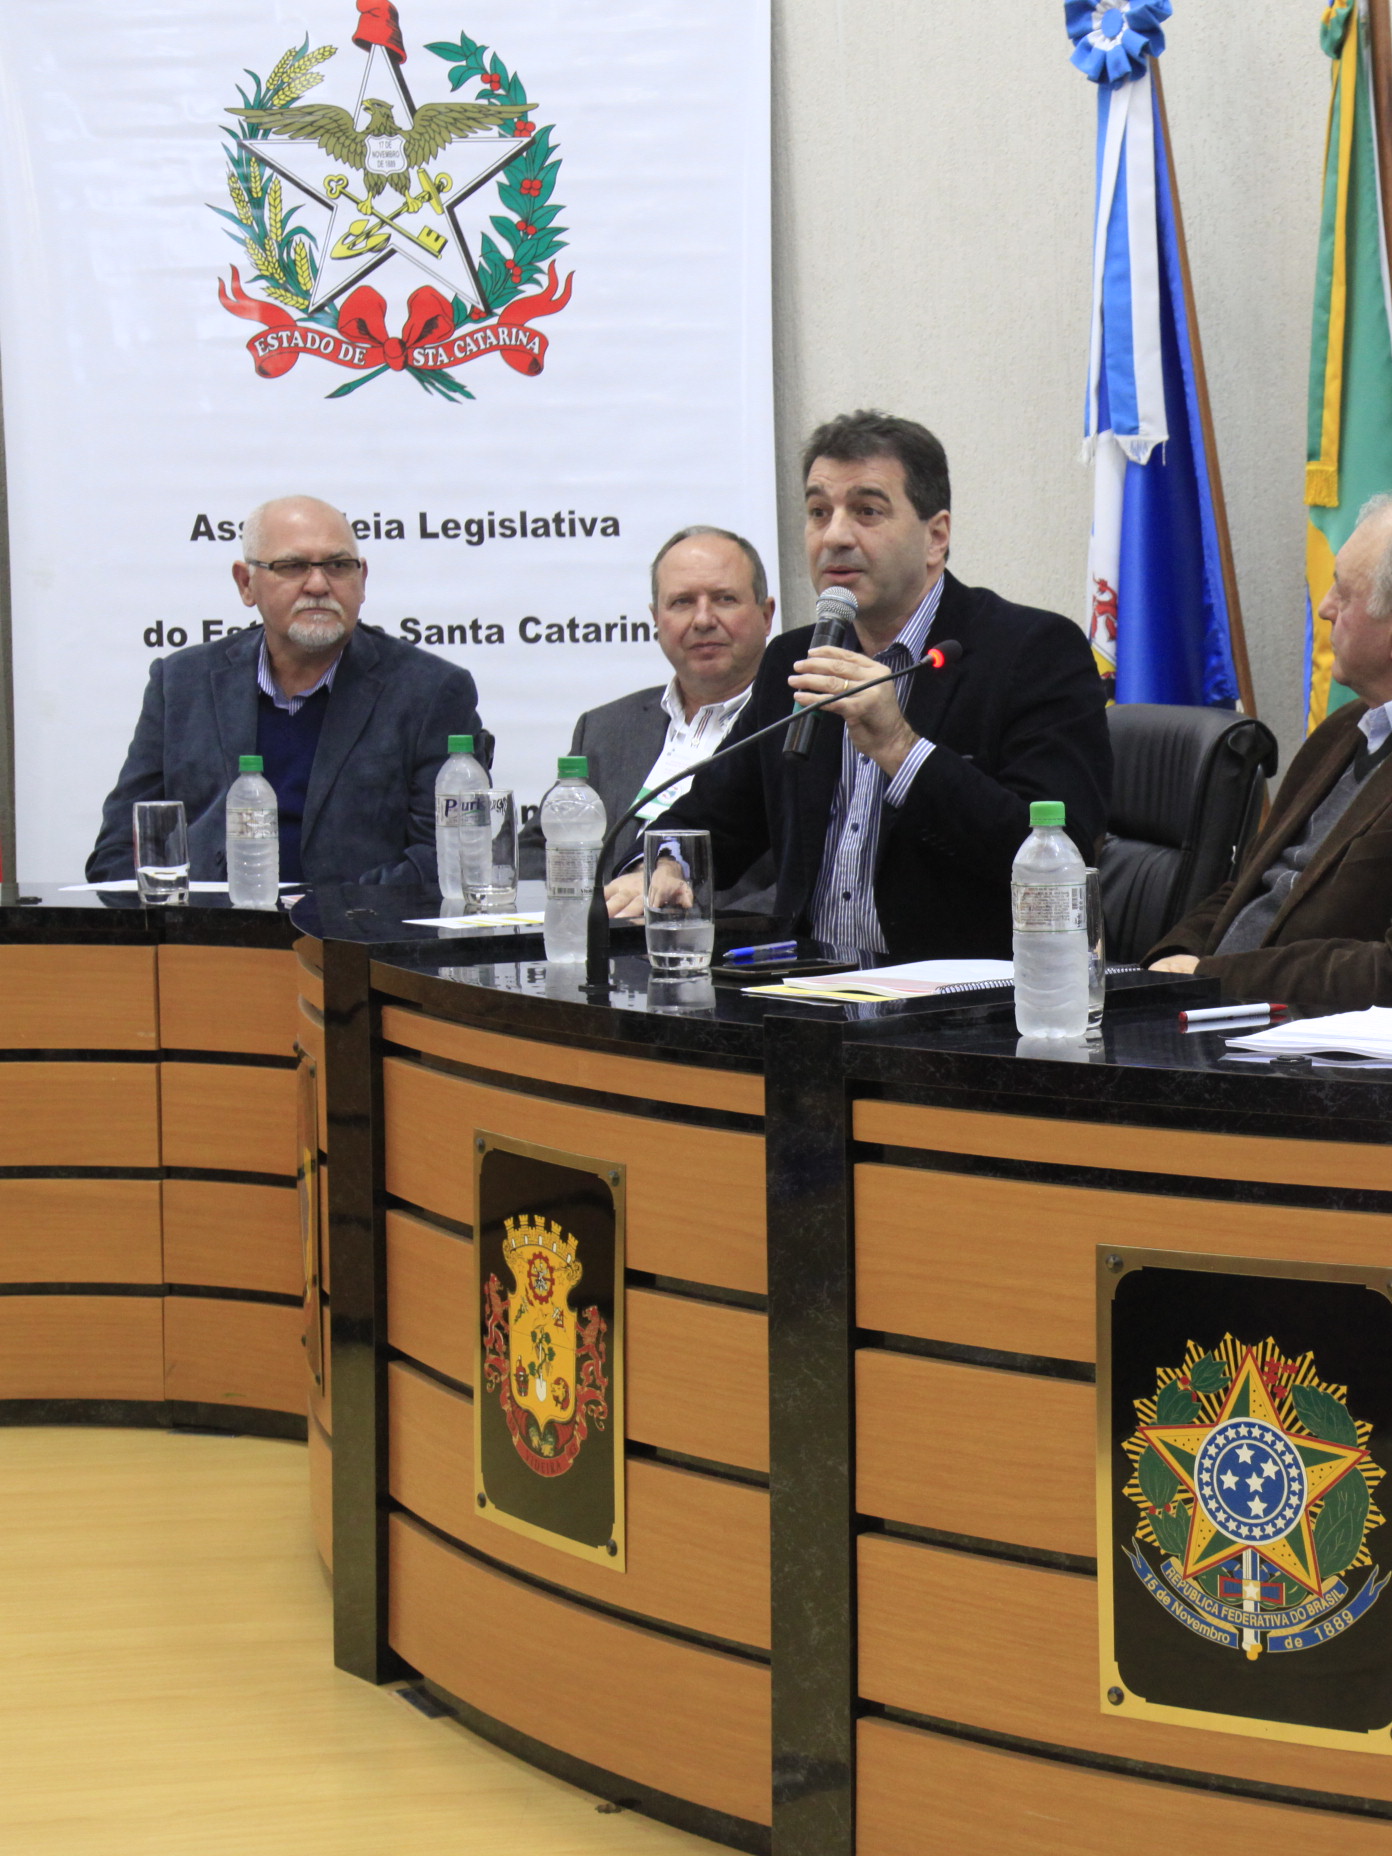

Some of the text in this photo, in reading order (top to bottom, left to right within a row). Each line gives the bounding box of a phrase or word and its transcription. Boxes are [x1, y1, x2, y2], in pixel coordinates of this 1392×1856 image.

[254, 329, 335, 357] ESTADO
[339, 344, 367, 366] DE
[190, 510, 620, 546] Aseia Legislativa
[143, 620, 188, 647] do
[400, 617, 505, 645] Santa
[1143, 1573, 1354, 1650] 15 de Novembro de 1889
[1165, 1567, 1346, 1628] REPUBLICA FEDERATIVA DO BRASIL
